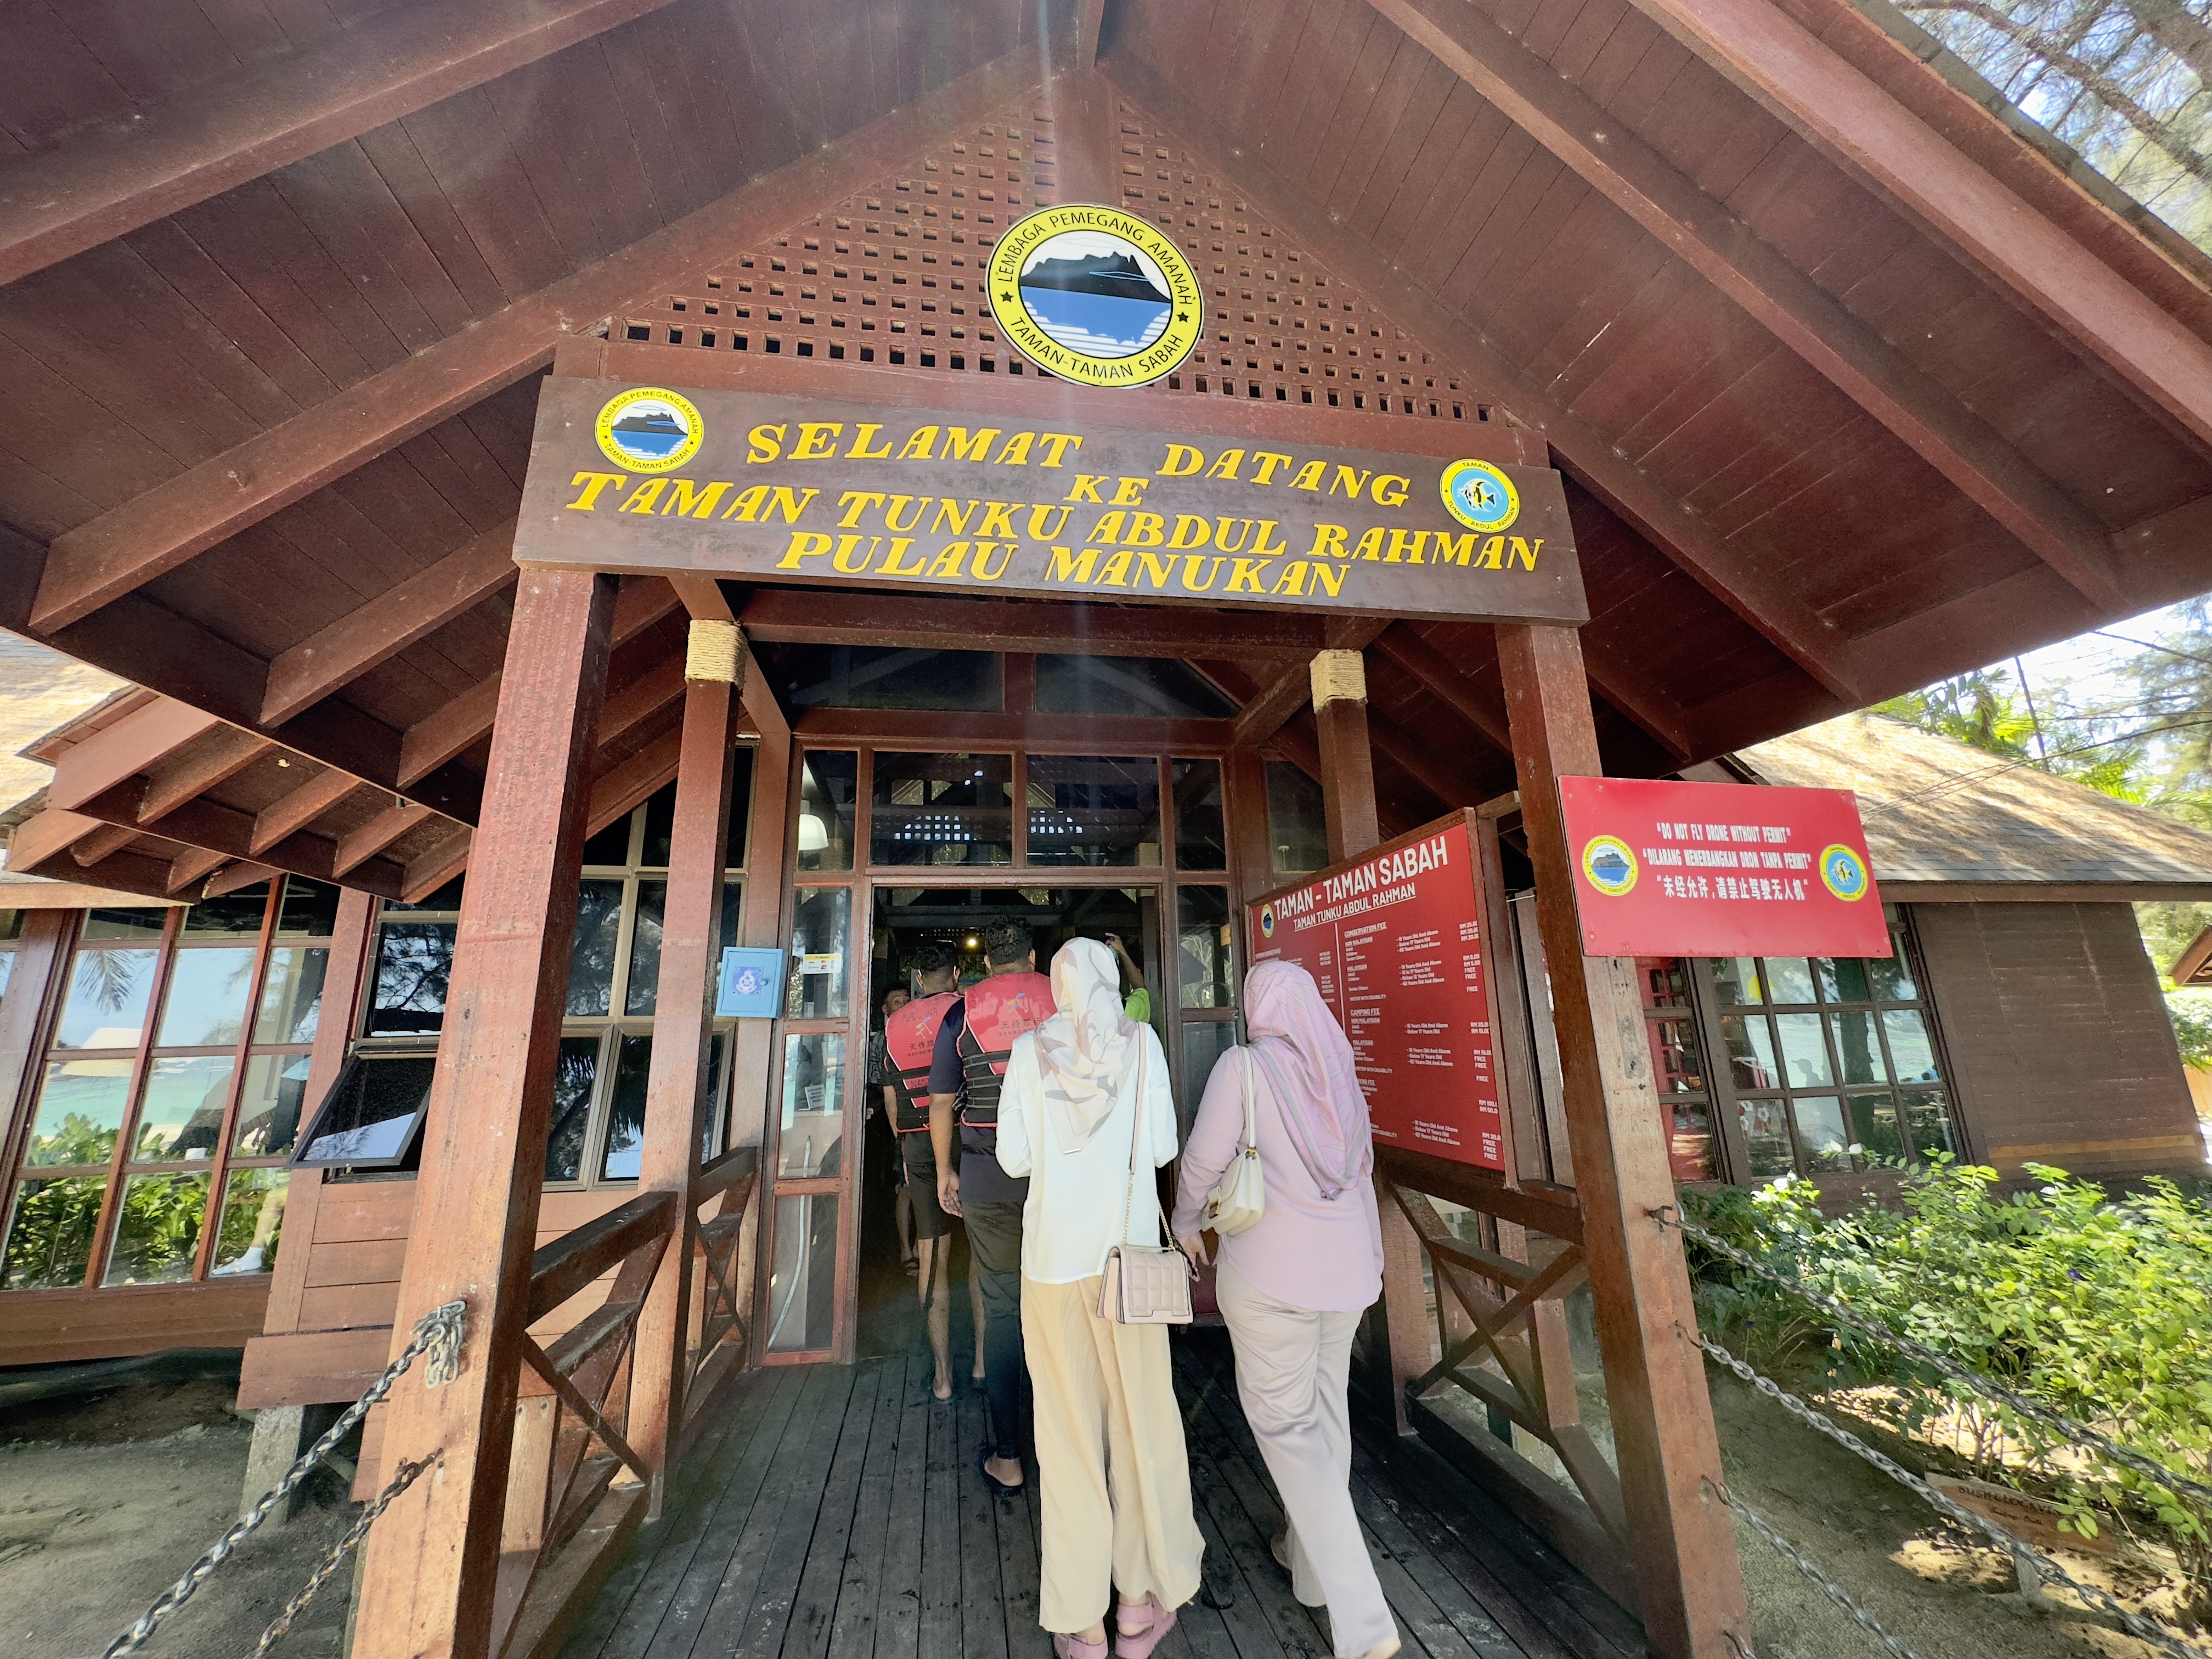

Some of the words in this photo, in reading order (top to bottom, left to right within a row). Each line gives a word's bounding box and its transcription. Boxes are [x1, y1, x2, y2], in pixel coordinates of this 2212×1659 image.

[998, 223, 1046, 283] LEMBAGA
[1049, 212, 1146, 241] PEMEGANG
[1148, 242, 1193, 304] AMANAH
[1011, 317, 1133, 379] TAMAN-TAMAN
[1139, 334, 1184, 373] SABAH
[601, 397, 629, 427] LEMBAGA
[630, 391, 681, 404] PEMEGANG
[681, 403, 698, 434] AMANAH
[663, 449, 690, 466] SABAH
[747, 422, 1084, 470] SELAMAT
[1158, 443, 1410, 507] DATANG
[1462, 462, 1488, 471] TAMAN
[1064, 475, 1149, 506] KE
[566, 471, 820, 524] TAMAN
[838, 490, 1073, 541] TUNKU
[1086, 511, 1288, 556] ABDUL
[1307, 523, 1545, 572] RAHMAN
[1448, 501, 1466, 520] TUNKU
[776, 532, 1018, 582] PULAU
[1045, 545, 1351, 598] MANUKAN
[1673, 823, 1689, 840] NOT
[1690, 823, 1703, 840] FLY
[1705, 824, 1729, 842] DRONE
[1729, 825, 1760, 843] WITHOUT
[1683, 849, 1739, 868] MENERBANGKAN
[1739, 851, 1760, 868] DRON
[1760, 851, 1784, 868] TANPA
[1274, 887, 1313, 921] TAMAN
[1323, 862, 1377, 904] TAMAN
[1379, 836, 1448, 885] SABAH
[1293, 913, 1316, 930] TAMAN
[1316, 905, 1342, 923] TUNKU
[1343, 896, 1372, 916] ABDUL
[1372, 882, 1416, 907] RAHMAN
[1483, 1139, 1496, 1147] FREE
[1483, 1146, 1497, 1154] FREE
[1484, 1153, 1497, 1161] FREE
